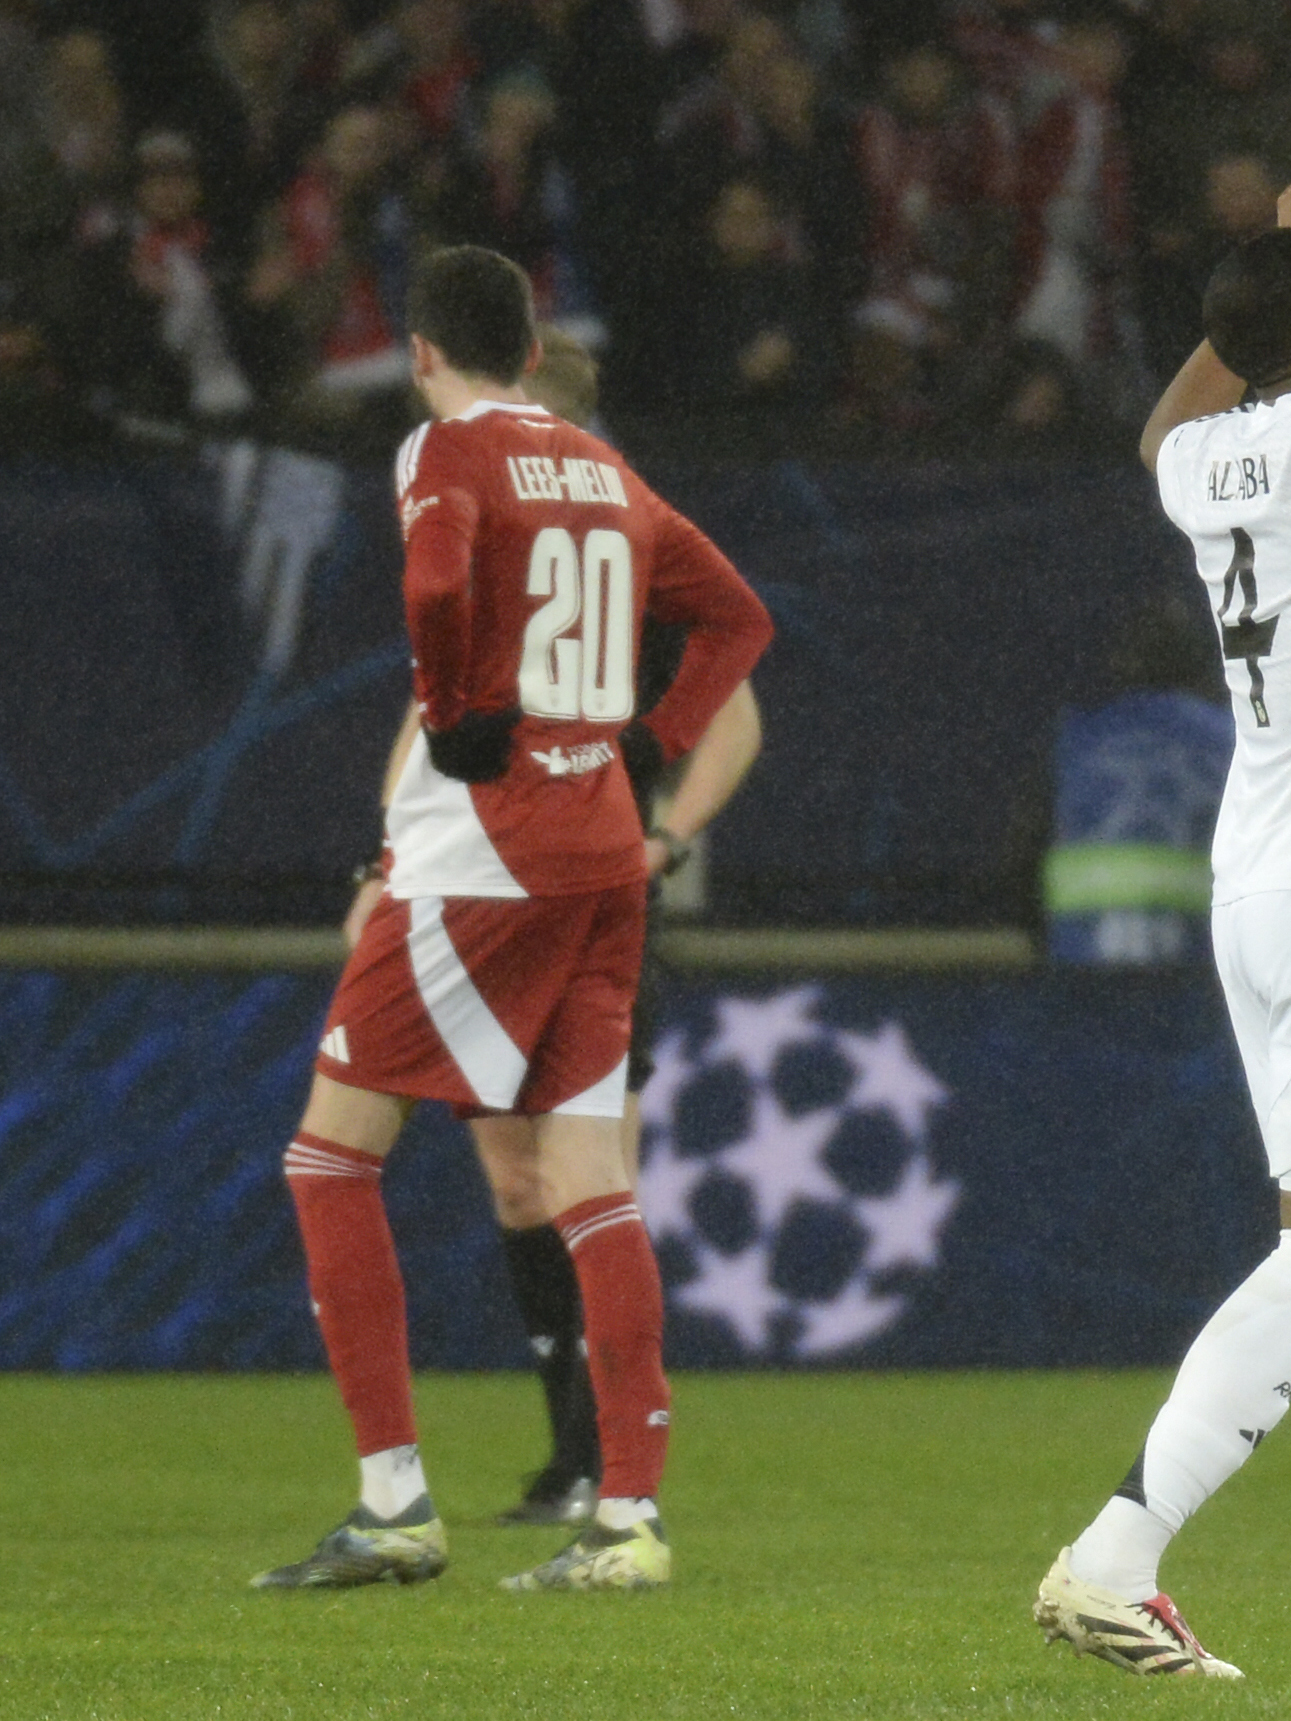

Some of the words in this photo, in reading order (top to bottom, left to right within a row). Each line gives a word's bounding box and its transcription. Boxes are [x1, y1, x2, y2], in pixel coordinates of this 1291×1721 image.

[1207, 454, 1270, 501] ALABA
[518, 528, 635, 720] 20
[1217, 527, 1280, 727] 4
